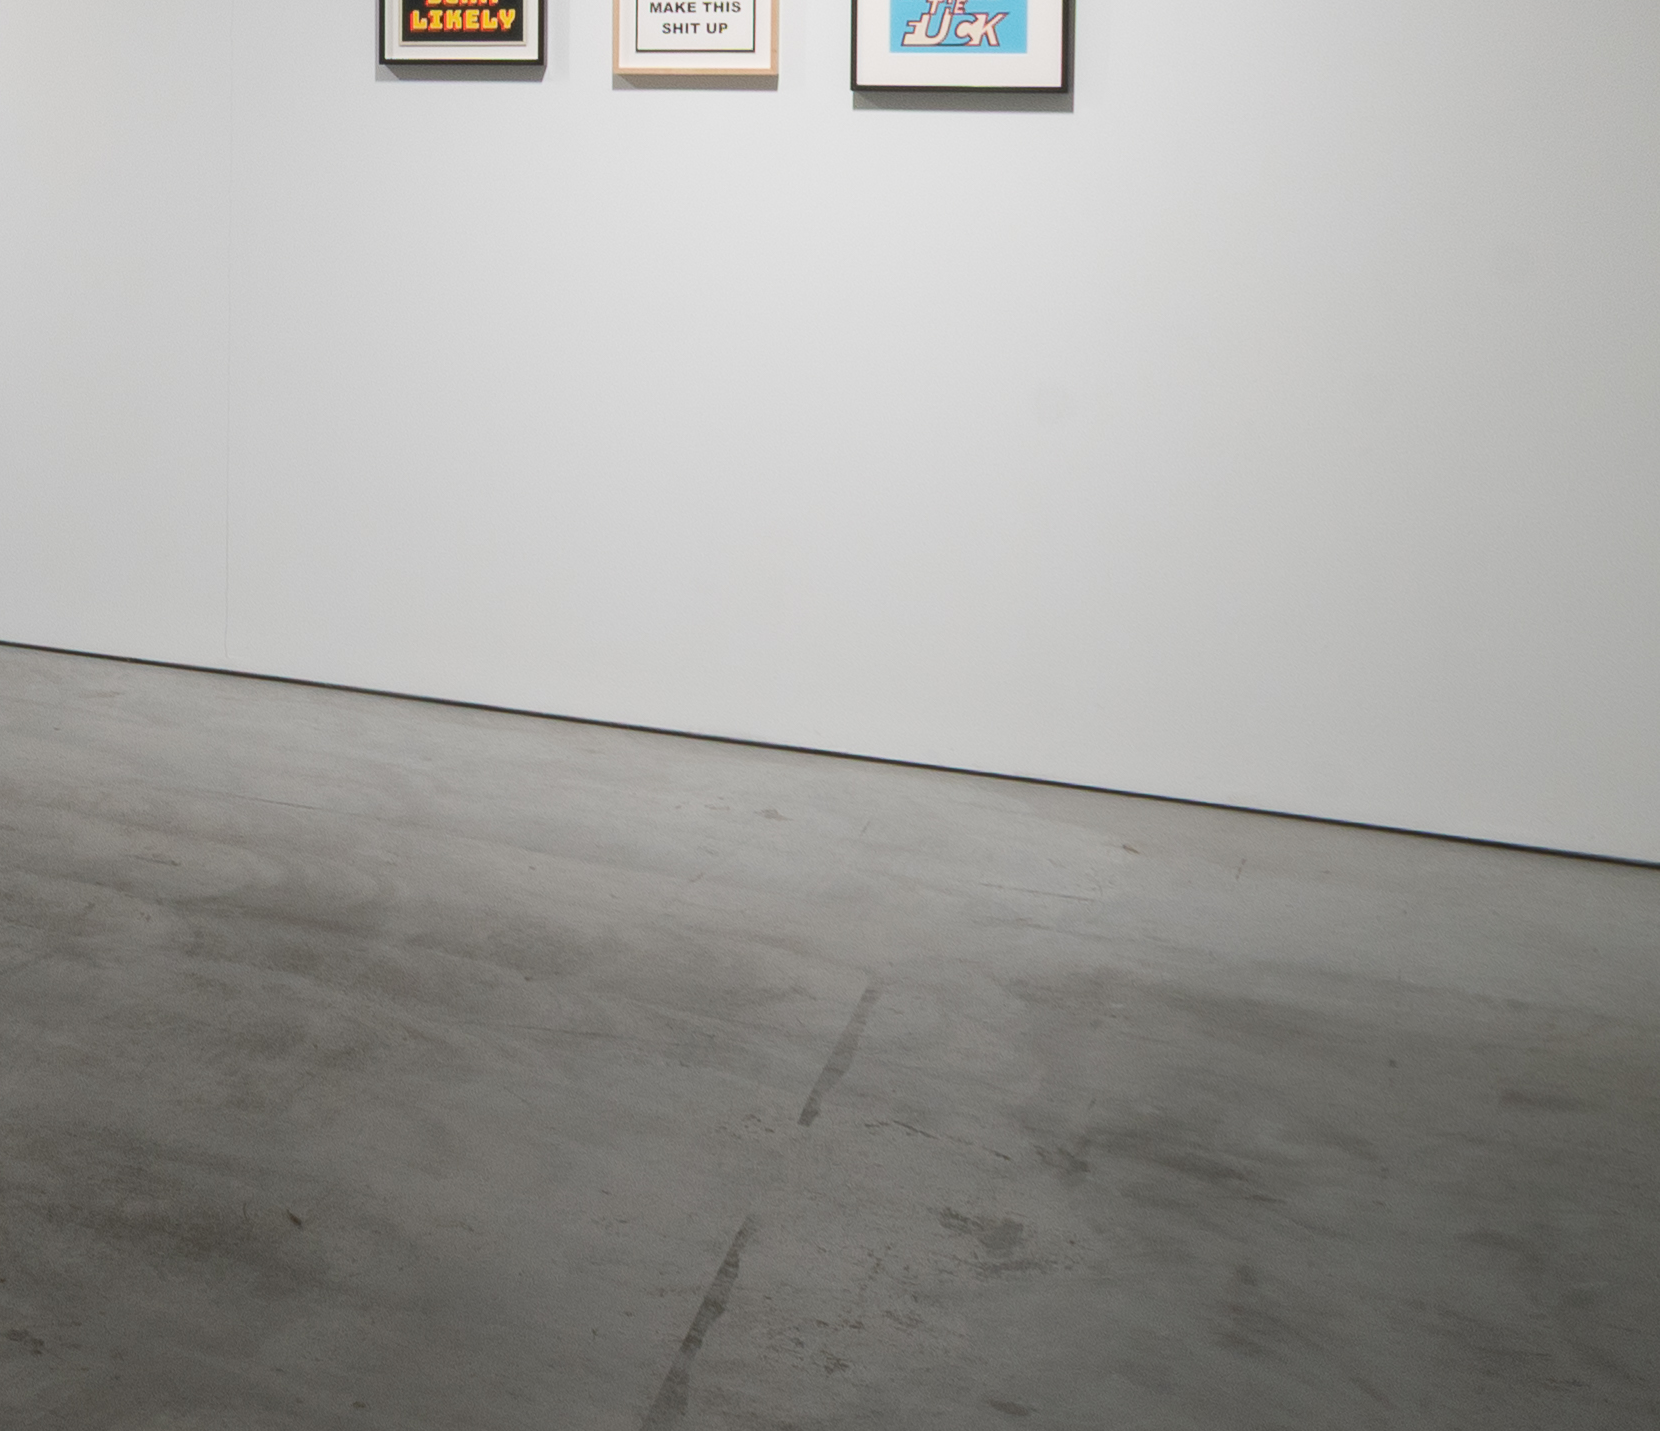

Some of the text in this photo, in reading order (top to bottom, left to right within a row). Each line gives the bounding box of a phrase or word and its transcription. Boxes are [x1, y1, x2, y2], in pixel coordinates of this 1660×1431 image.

[649, 0, 742, 14] MAKE THIS
[410, 9, 516, 32] LIKELY
[662, 22, 728, 35] SHIT UP
